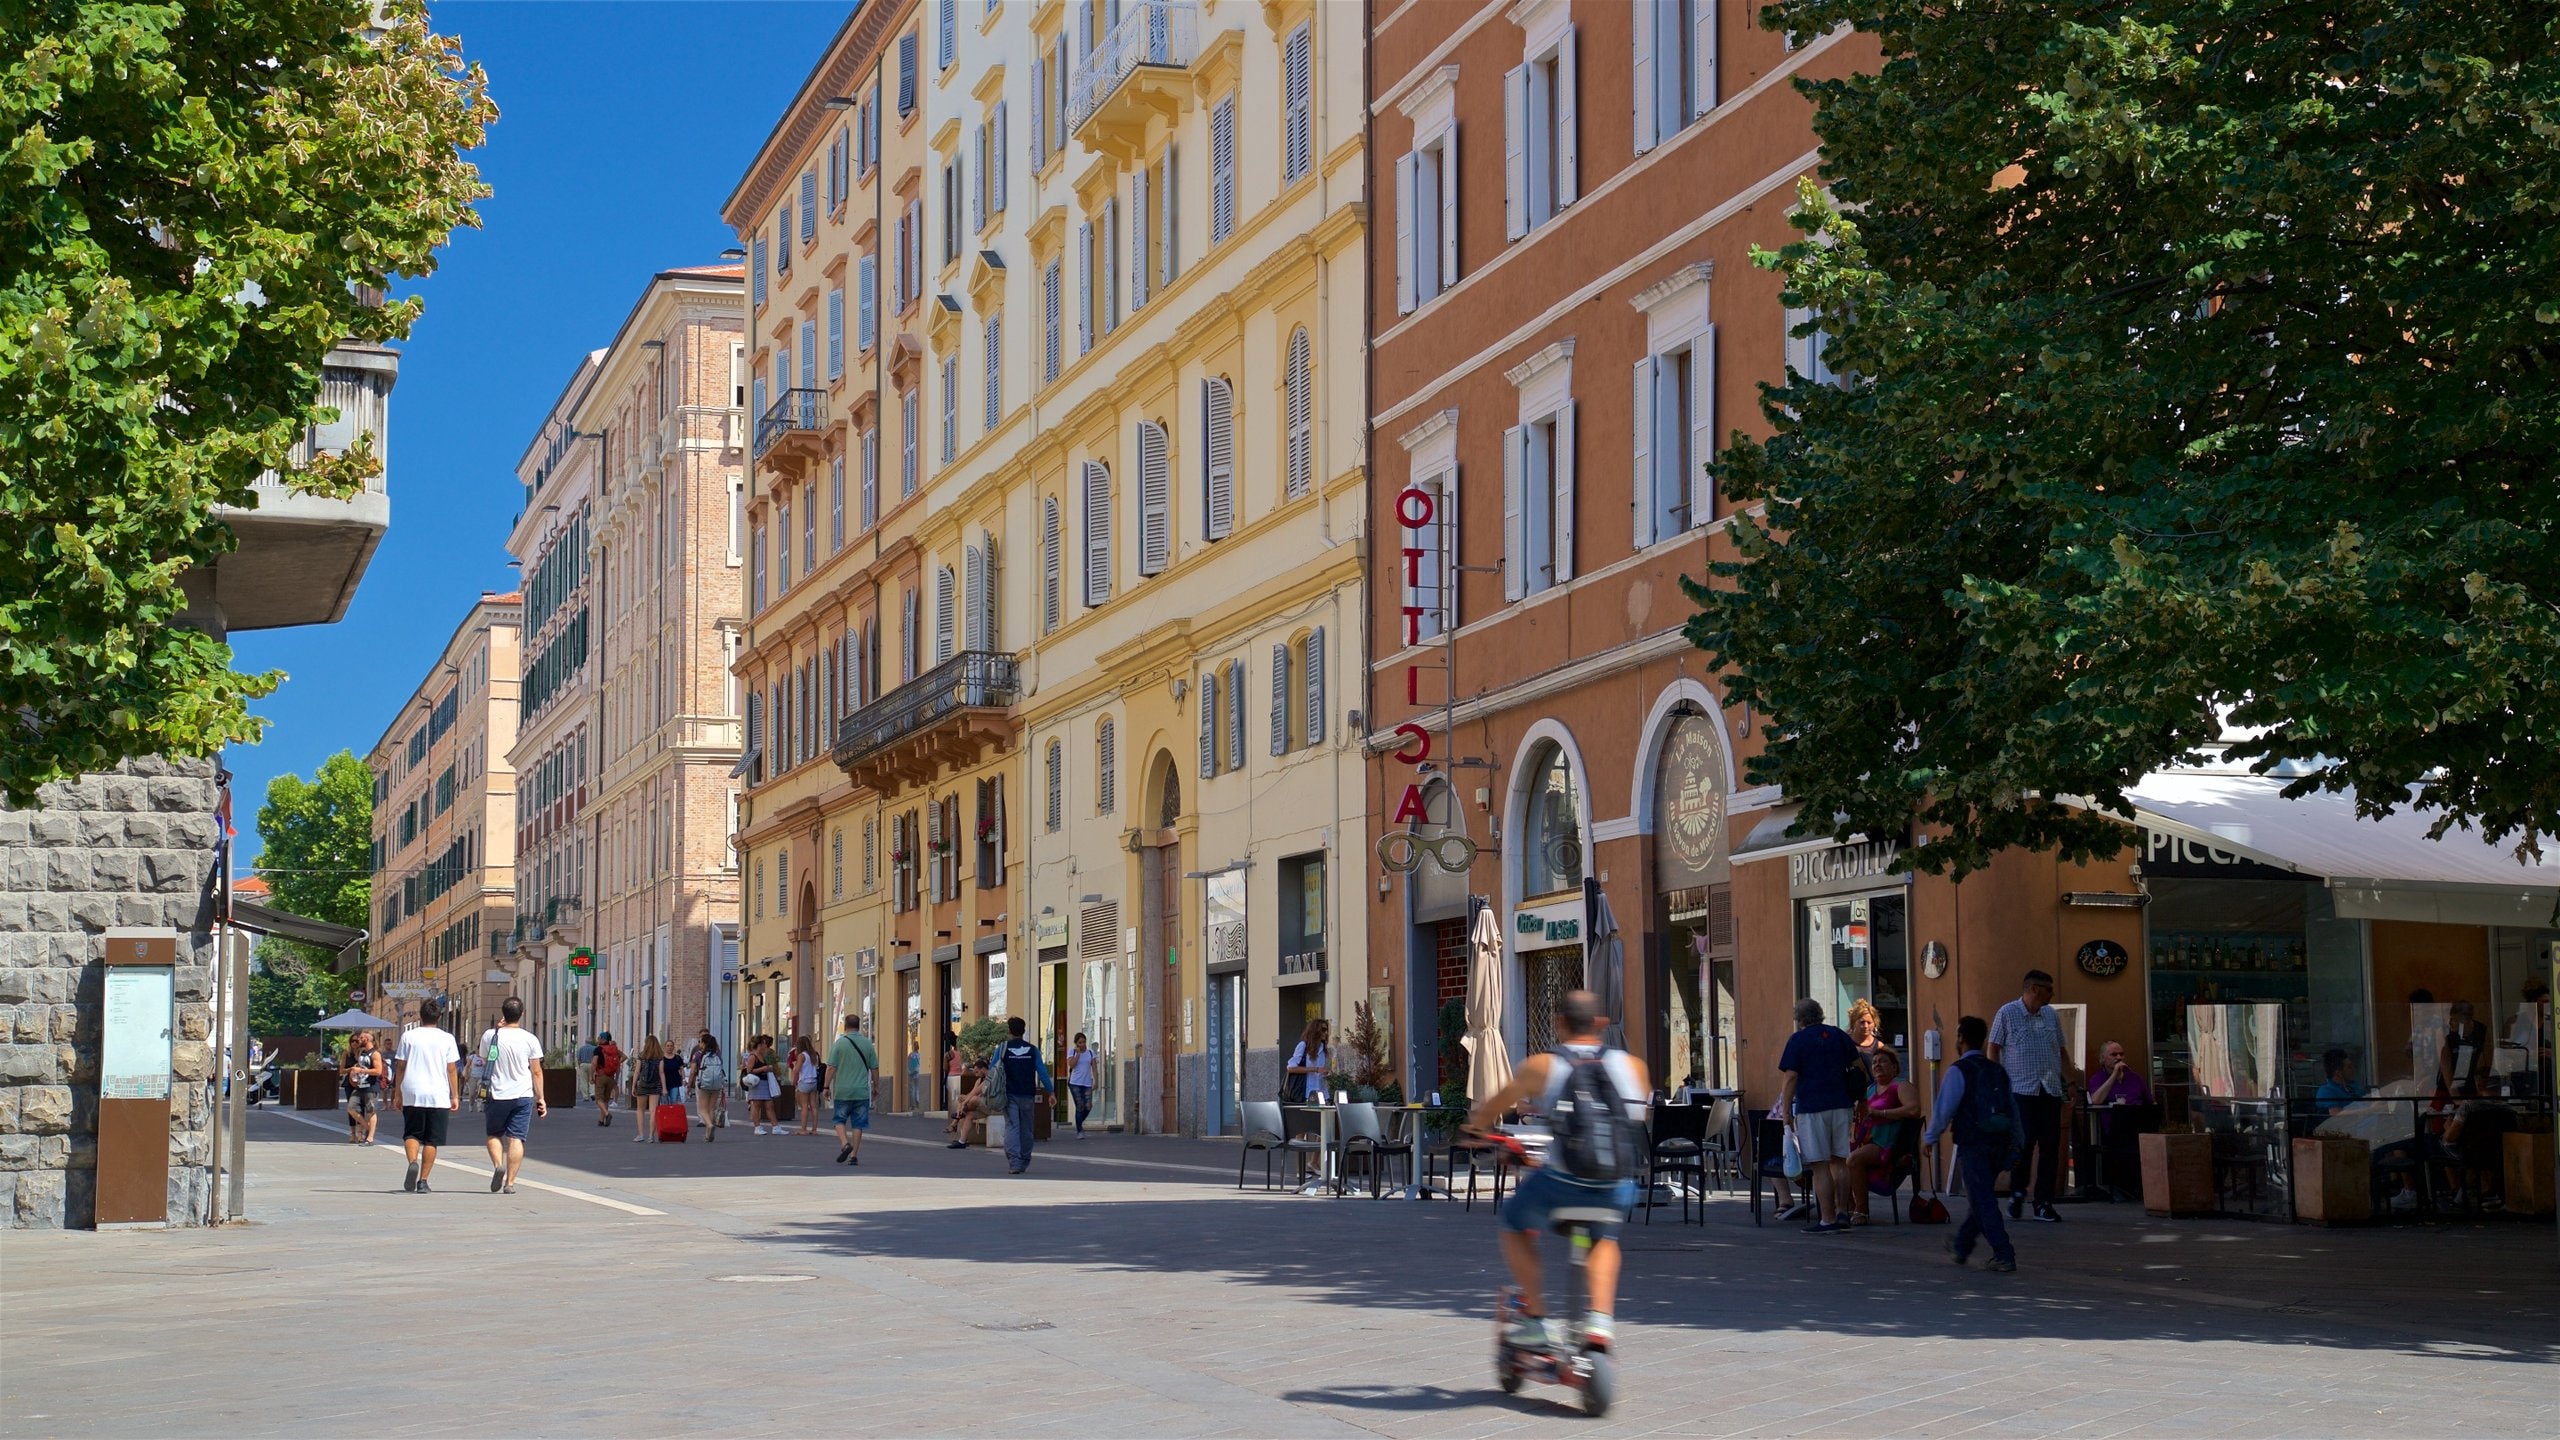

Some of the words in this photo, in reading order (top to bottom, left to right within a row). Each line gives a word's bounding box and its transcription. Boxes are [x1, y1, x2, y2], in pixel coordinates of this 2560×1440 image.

[1676, 743, 1685, 761] La
[1685, 730, 1712, 758] Maison
[1670, 801, 1676, 821] du
[1699, 792, 1719, 855] Marseille
[1672, 822, 1690, 856] Savon
[1690, 844, 1699, 857] de
[1793, 839, 1898, 887] PICCADILLY
[1284, 952, 1317, 974] TAXI
[1209, 982, 1218, 1091] CAPELLOMANIA
